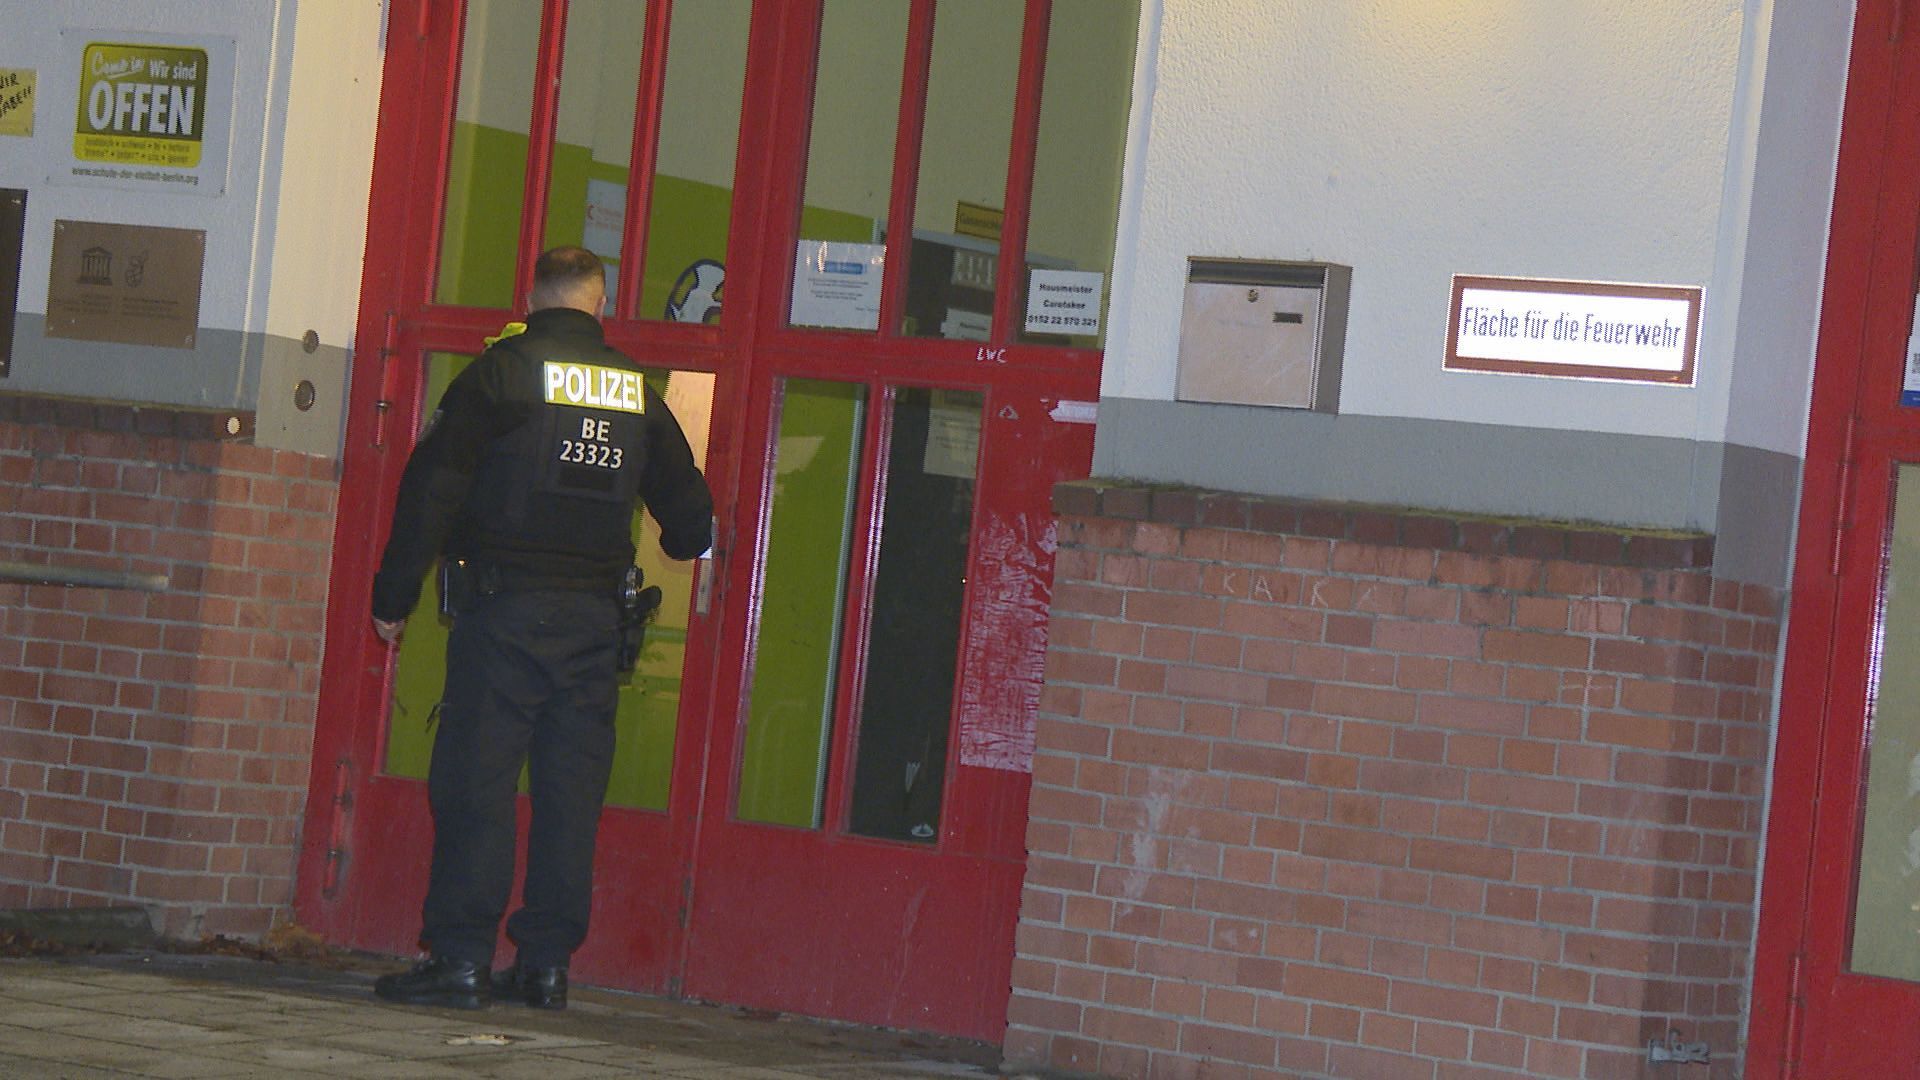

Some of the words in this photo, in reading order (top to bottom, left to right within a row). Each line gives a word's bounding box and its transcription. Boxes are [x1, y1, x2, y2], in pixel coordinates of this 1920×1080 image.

[149, 59, 171, 79] Wir
[172, 61, 198, 80] sind
[88, 80, 196, 136] OFFEN
[1039, 283, 1093, 294] Hausmeister
[1051, 315, 1062, 325] 22
[1462, 306, 1519, 338] Fläche
[1524, 310, 1549, 340] für
[1552, 312, 1579, 342] die
[1584, 313, 1681, 349] Feuerwehr
[546, 364, 643, 411] POLIZEI
[581, 417, 611, 442] BE
[559, 440, 624, 469] 23323
